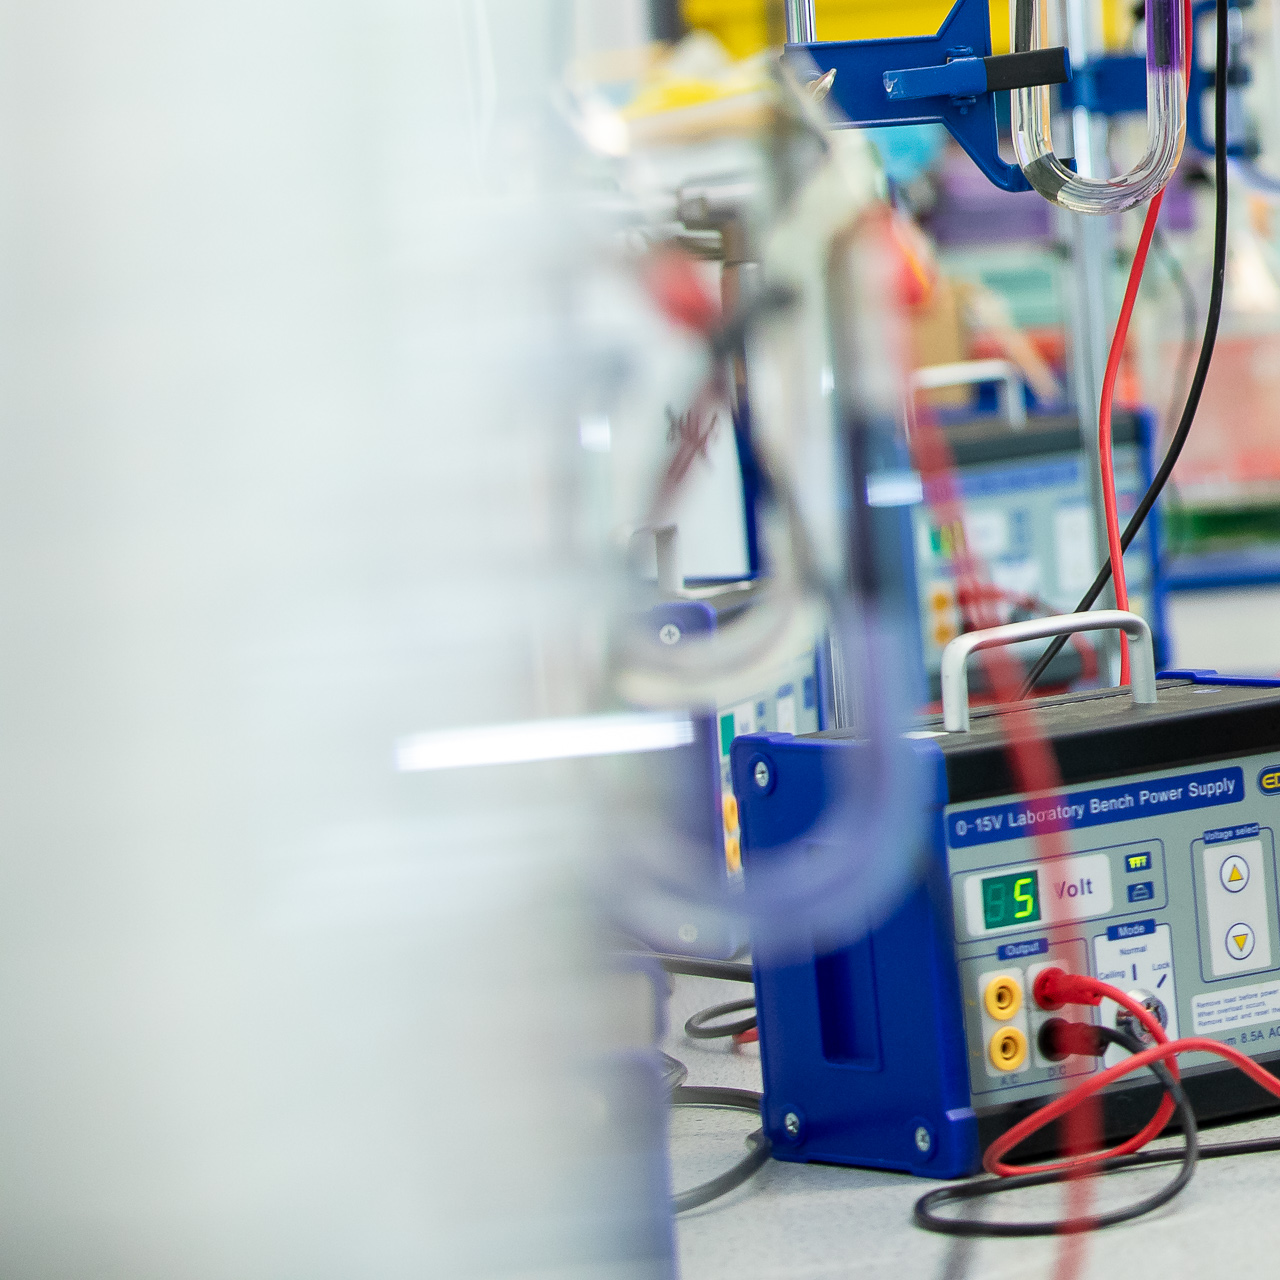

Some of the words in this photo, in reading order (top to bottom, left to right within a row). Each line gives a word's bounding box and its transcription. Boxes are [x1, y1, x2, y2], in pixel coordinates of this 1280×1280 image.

[955, 813, 1003, 836] 0-15V
[1008, 804, 1085, 827] Laboratory
[1090, 793, 1135, 813] Bench
[1139, 787, 1183, 805] Power
[1188, 777, 1235, 797] Supply
[1204, 830, 1233, 841] Voltage
[1235, 825, 1259, 835] select
[1053, 878, 1093, 899] Volt
[1013, 878, 1034, 918] 5
[1117, 923, 1145, 937] Mode
[1005, 942, 1040, 957] Output
[1120, 945, 1147, 955] Normal
[1152, 962, 1170, 971] Lock
[1260, 989, 1279, 998] power
[1240, 1030, 1265, 1044] 8.5A
